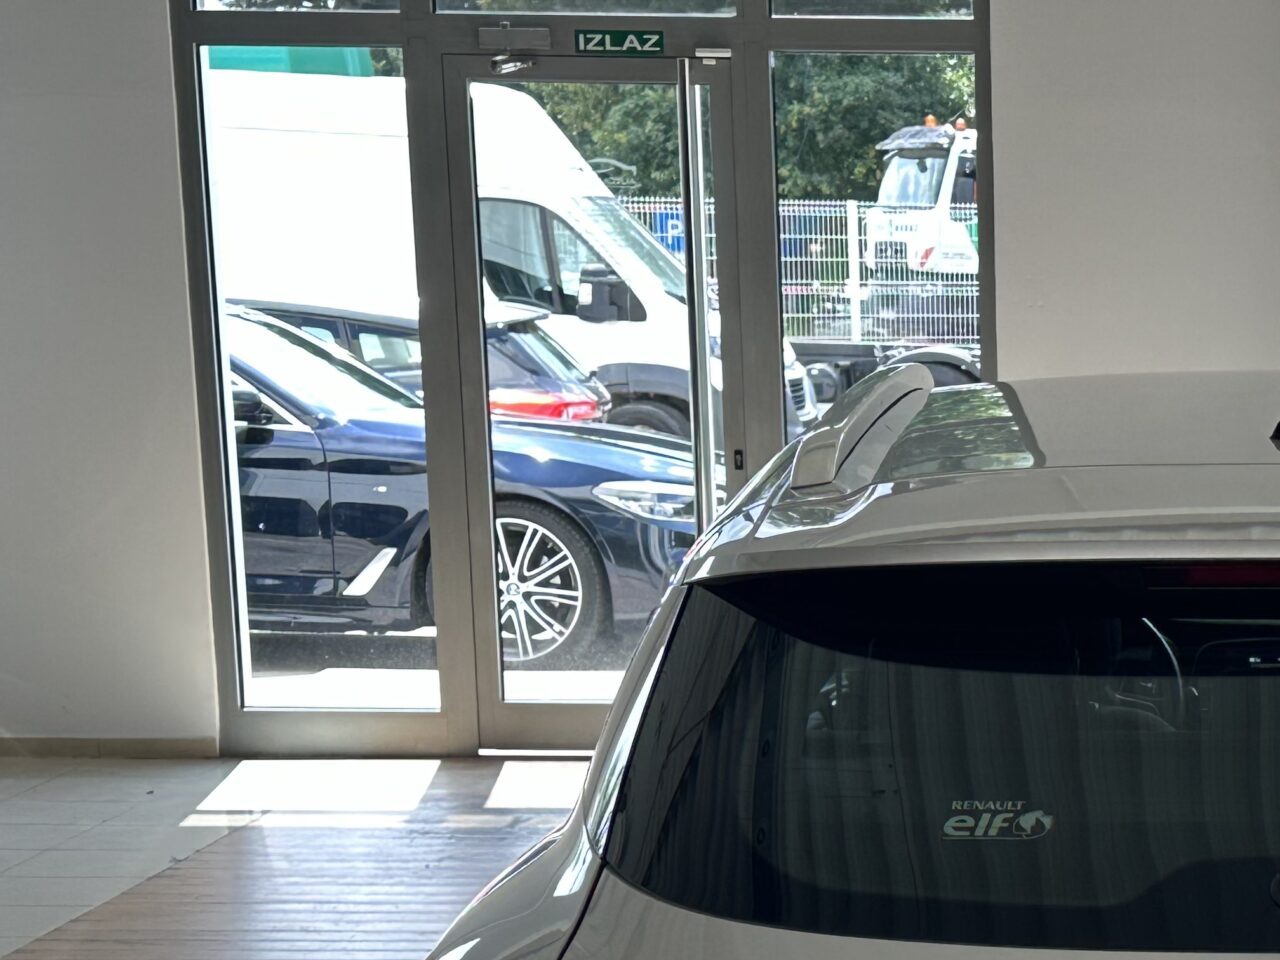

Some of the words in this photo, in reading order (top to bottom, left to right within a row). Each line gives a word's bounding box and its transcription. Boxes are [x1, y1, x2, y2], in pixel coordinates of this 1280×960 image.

[578, 33, 661, 51] IZLAZ
[952, 800, 1026, 810] RENAULT
[943, 813, 1014, 836] elf
